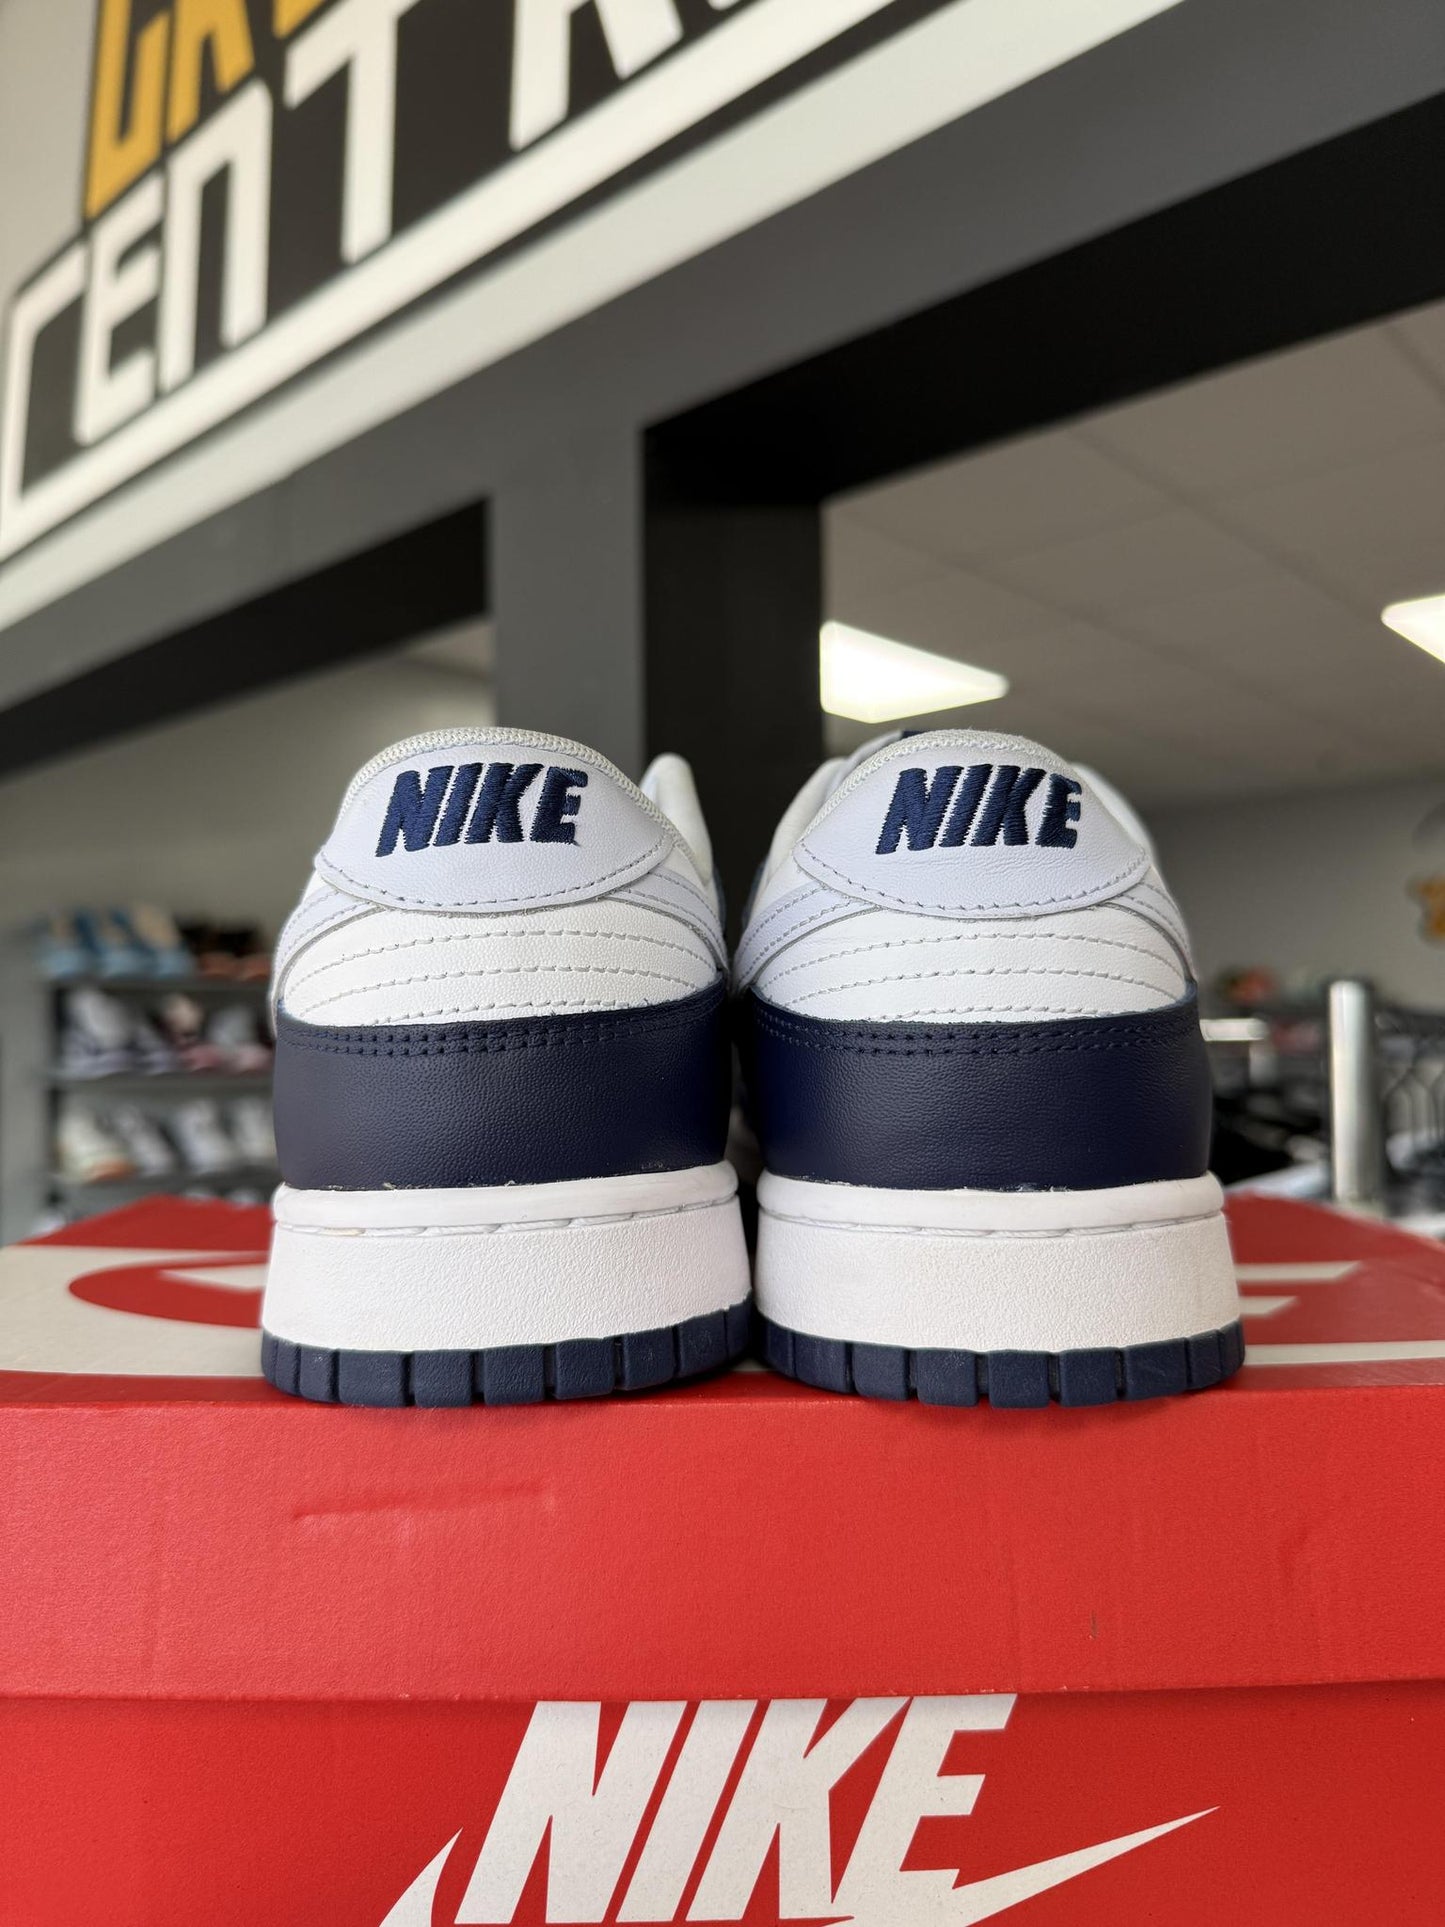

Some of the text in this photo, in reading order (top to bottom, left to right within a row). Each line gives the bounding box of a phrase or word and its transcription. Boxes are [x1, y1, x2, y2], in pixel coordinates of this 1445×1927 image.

[375, 762, 588, 858] NIKE
[875, 763, 1083, 855] NIKE
[454, 1692, 1018, 1925] NIKE
